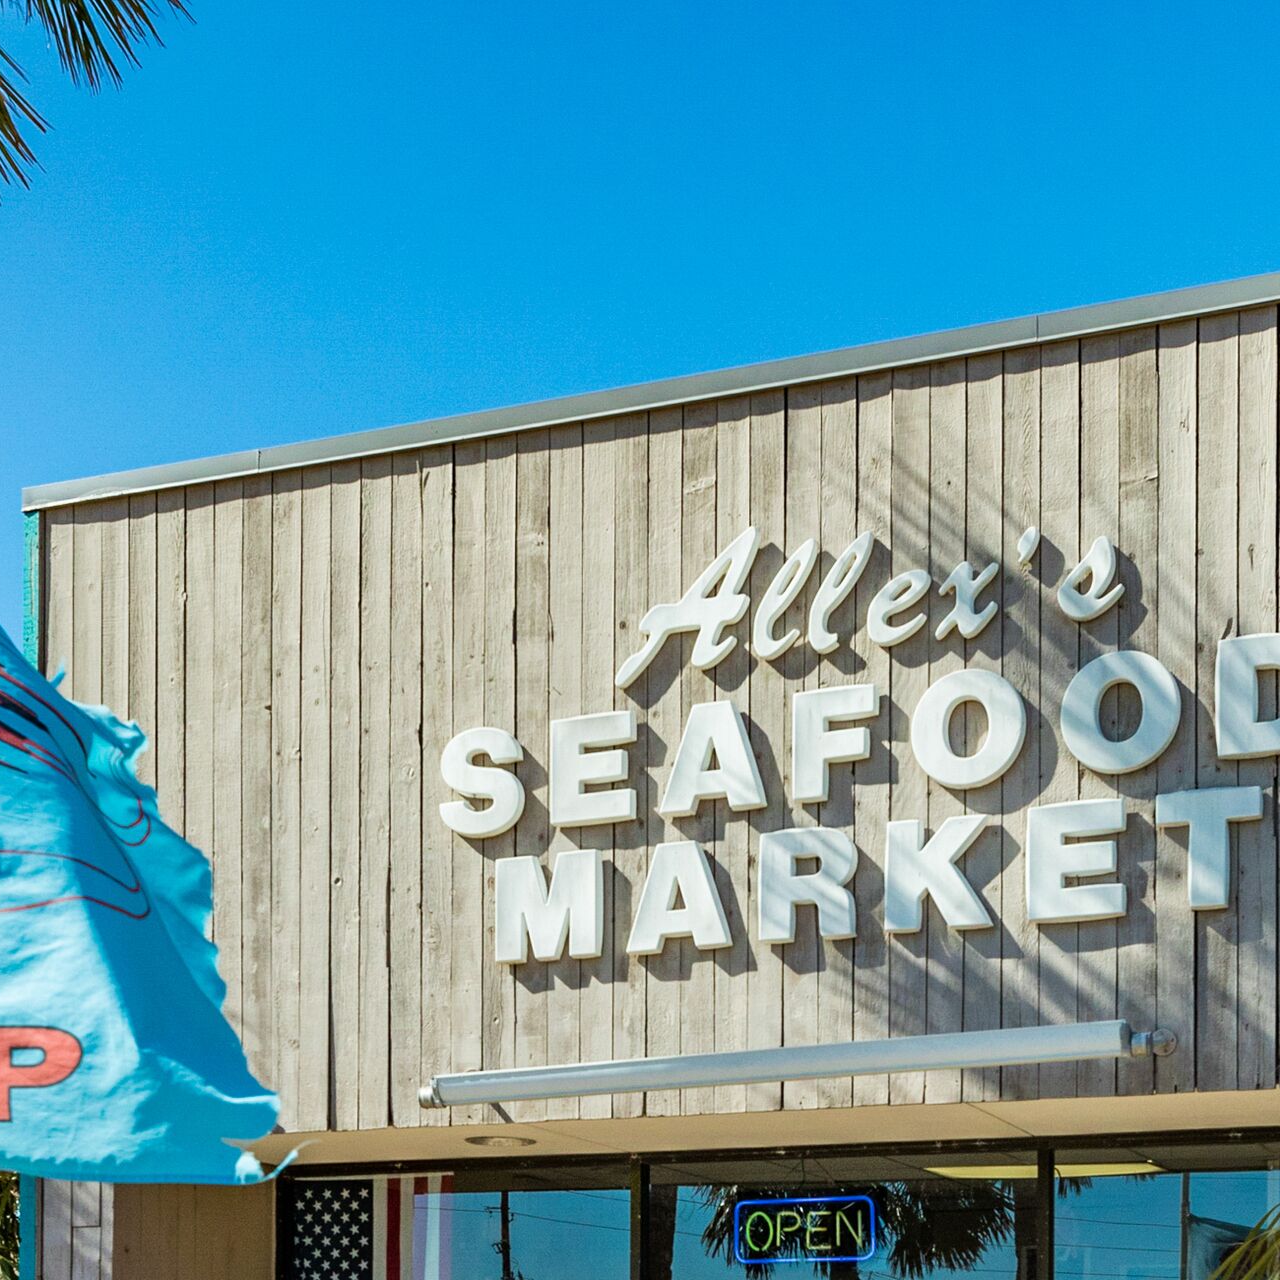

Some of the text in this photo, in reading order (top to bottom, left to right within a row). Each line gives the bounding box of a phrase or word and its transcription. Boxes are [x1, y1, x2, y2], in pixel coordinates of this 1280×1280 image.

[615, 525, 1127, 690] Allex's
[493, 785, 1264, 965] MARKET
[745, 1209, 864, 1252] OPEN
